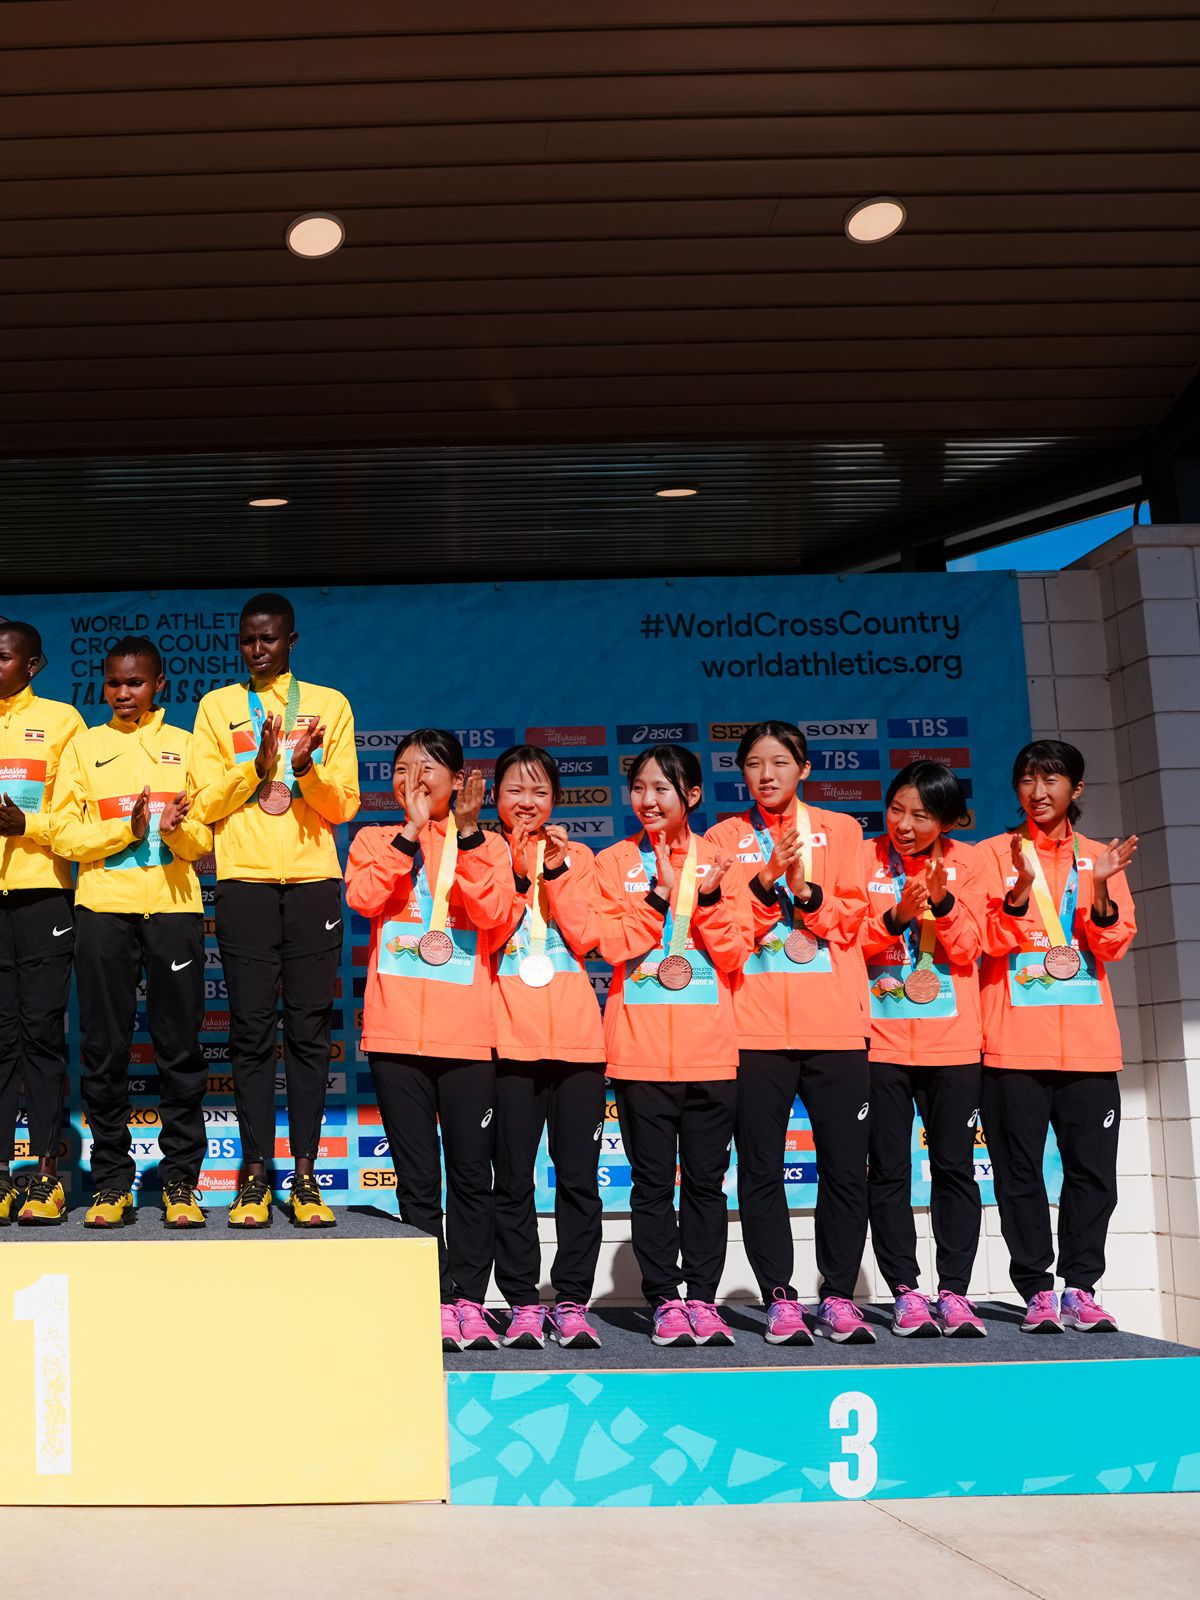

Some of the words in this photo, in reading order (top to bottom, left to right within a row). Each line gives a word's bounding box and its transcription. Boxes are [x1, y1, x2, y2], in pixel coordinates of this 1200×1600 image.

[71, 614, 149, 633] WORLD
[156, 612, 240, 631] ATHLET
[640, 610, 960, 640] #WorldCrossCountry
[159, 633, 240, 653] COUNT
[701, 650, 963, 680] worldathletics.org
[649, 727, 683, 740] asics
[806, 724, 869, 737] SONY
[907, 719, 948, 737] TBS
[455, 730, 496, 748] TBS
[544, 732, 587, 744] Tallahassee
[559, 760, 593, 773] asics
[822, 751, 860, 770] TBS
[366, 763, 393, 780] TB
[558, 788, 608, 804] EIKO
[821, 787, 863, 798] Tallahassee
[205, 981, 228, 999] BS
[203, 1048, 229, 1059] asic
[208, 1139, 235, 1158] BS
[198, 1176, 237, 1187] allahassee
[13, 1274, 72, 1474] 1
[829, 1391, 878, 1499] 3
